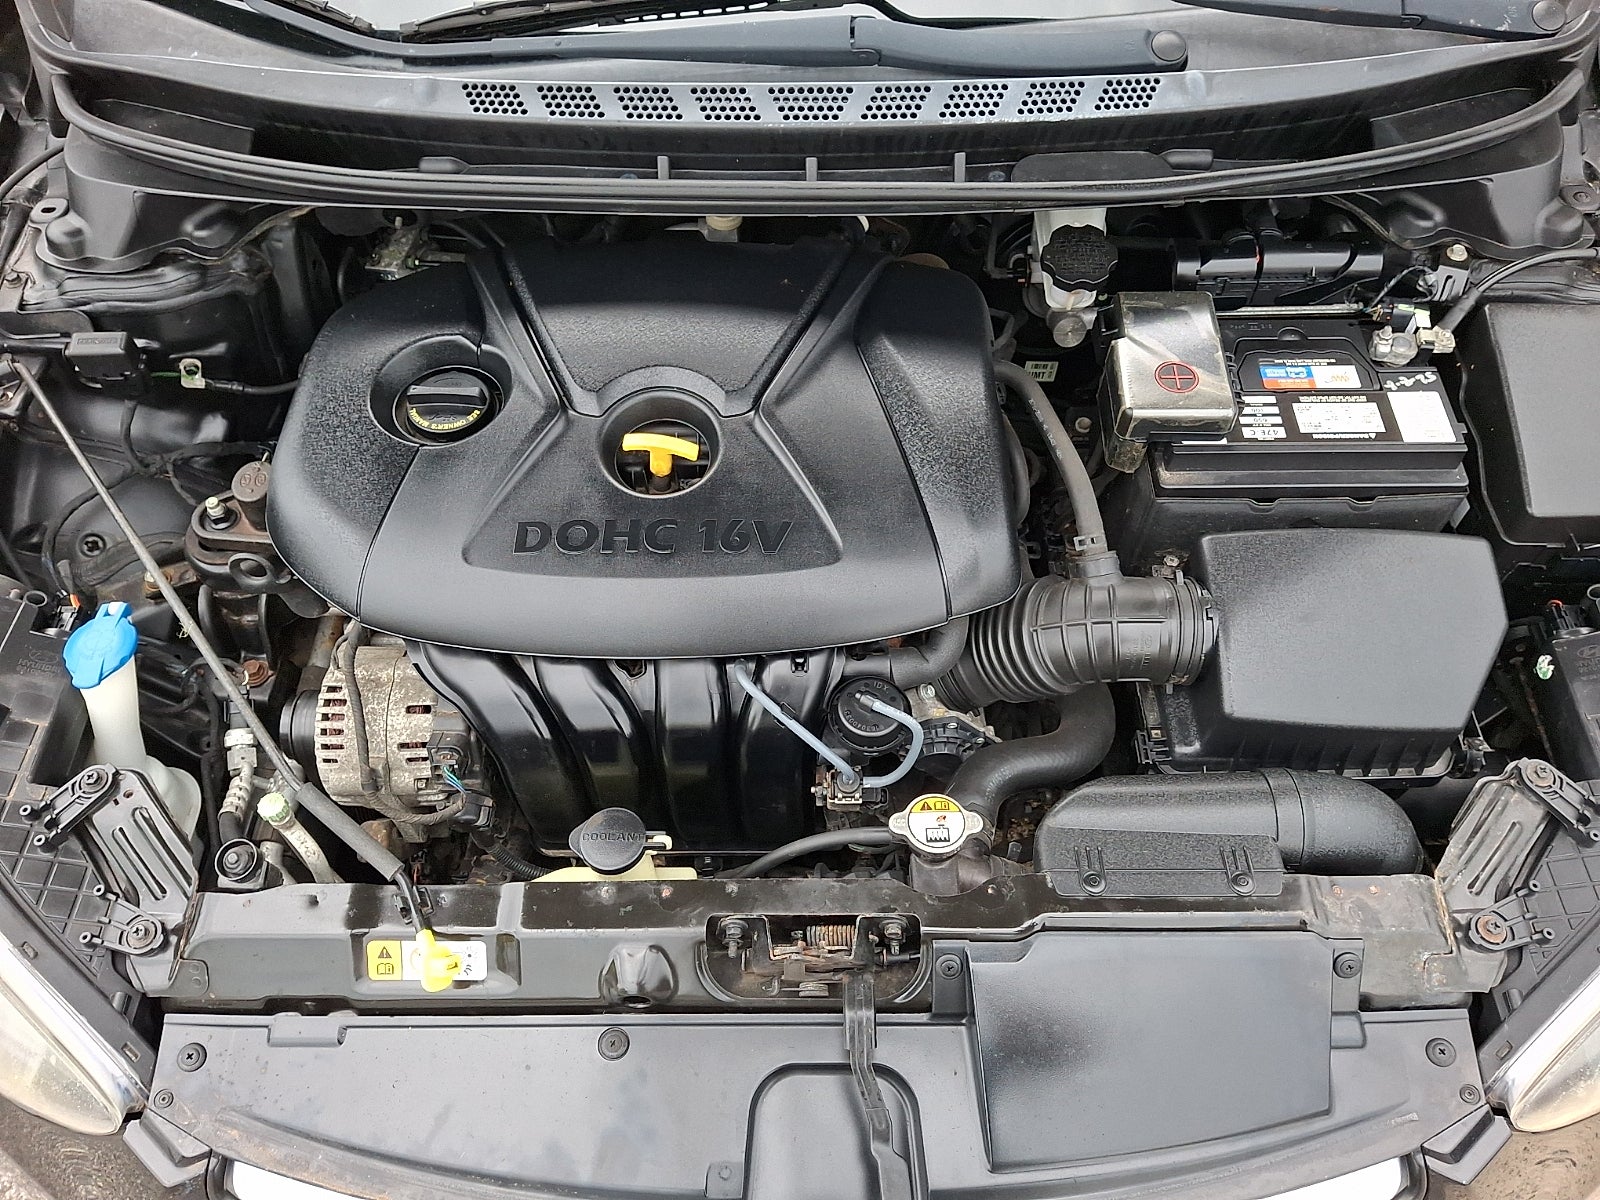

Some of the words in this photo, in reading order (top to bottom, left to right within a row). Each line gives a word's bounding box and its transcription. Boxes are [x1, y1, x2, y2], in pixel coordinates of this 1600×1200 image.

[409, 408, 430, 427] MANUAL
[466, 409, 481, 421] SEE
[430, 419, 467, 430] OWNER'S
[512, 518, 678, 555] DOHC
[697, 518, 794, 555] 16V
[582, 832, 646, 843] COOLANT
